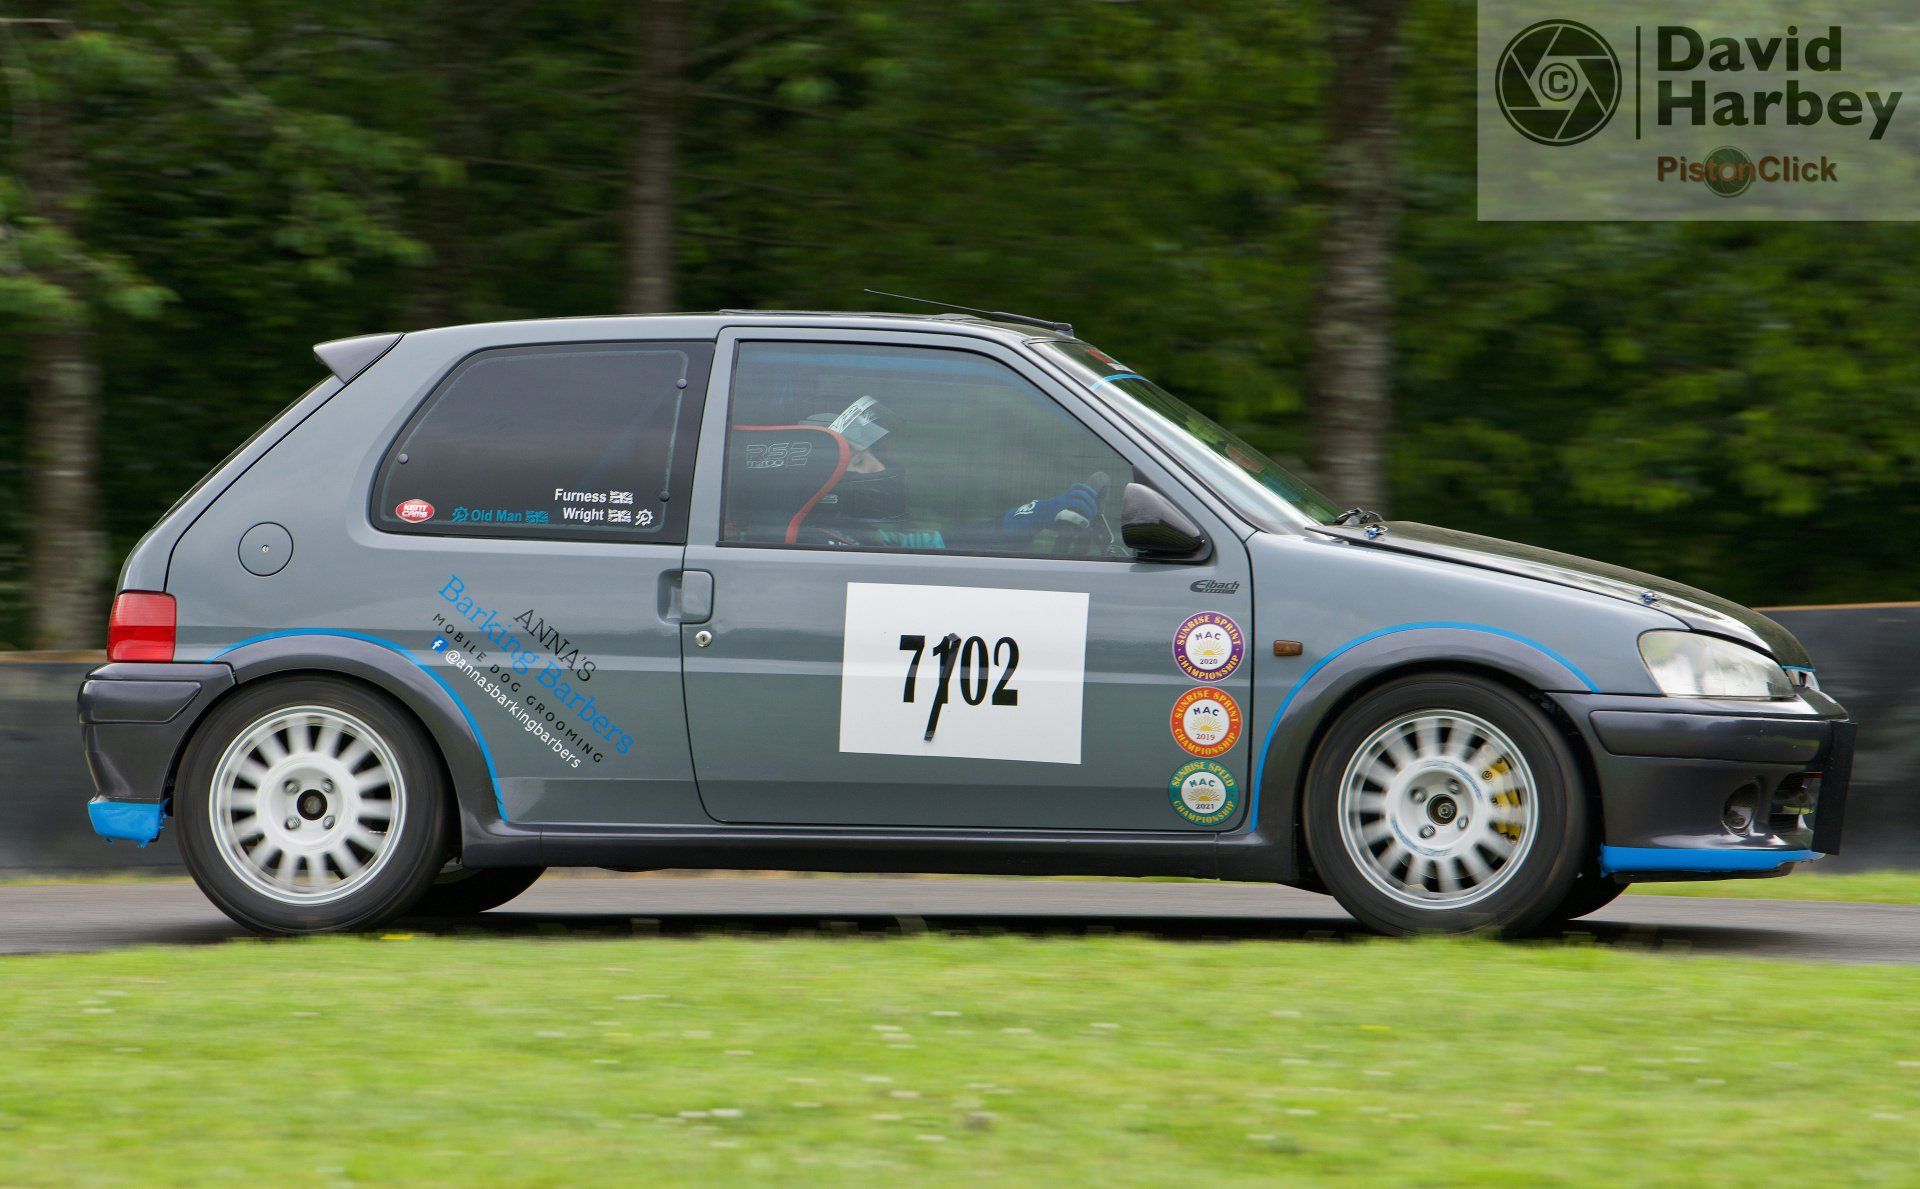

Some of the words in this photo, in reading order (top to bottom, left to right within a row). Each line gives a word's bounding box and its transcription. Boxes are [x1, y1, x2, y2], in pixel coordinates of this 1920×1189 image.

[403, 504, 428, 512] KENT
[554, 488, 607, 503] Furness
[471, 509, 497, 522] Old
[499, 509, 522, 522] Man
[562, 507, 604, 522] Wright
[1190, 580, 1240, 593] Eibach
[1177, 615, 1210, 646] SUNRISE
[1214, 616, 1241, 645] SPRINT
[513, 609, 596, 682] ANNA'S
[438, 575, 540, 676] Barking
[536, 662, 635, 755] Barbers
[1177, 654, 1239, 680] CHAMPIONSHIP
[433, 613, 487, 662] MOBILE
[489, 664, 521, 692] DOG
[526, 695, 603, 763] GROOMING
[445, 649, 582, 768] @annasbarkingbarbers
[1174, 690, 1210, 719] SUNRISE
[1213, 691, 1239, 723] SPRINT
[1175, 728, 1236, 755] CHAMPIONSHIP
[1172, 761, 1207, 787] SUNRISE
[1208, 762, 1235, 787] SPEED
[1173, 800, 1235, 824] CHAMPIONSHIP
